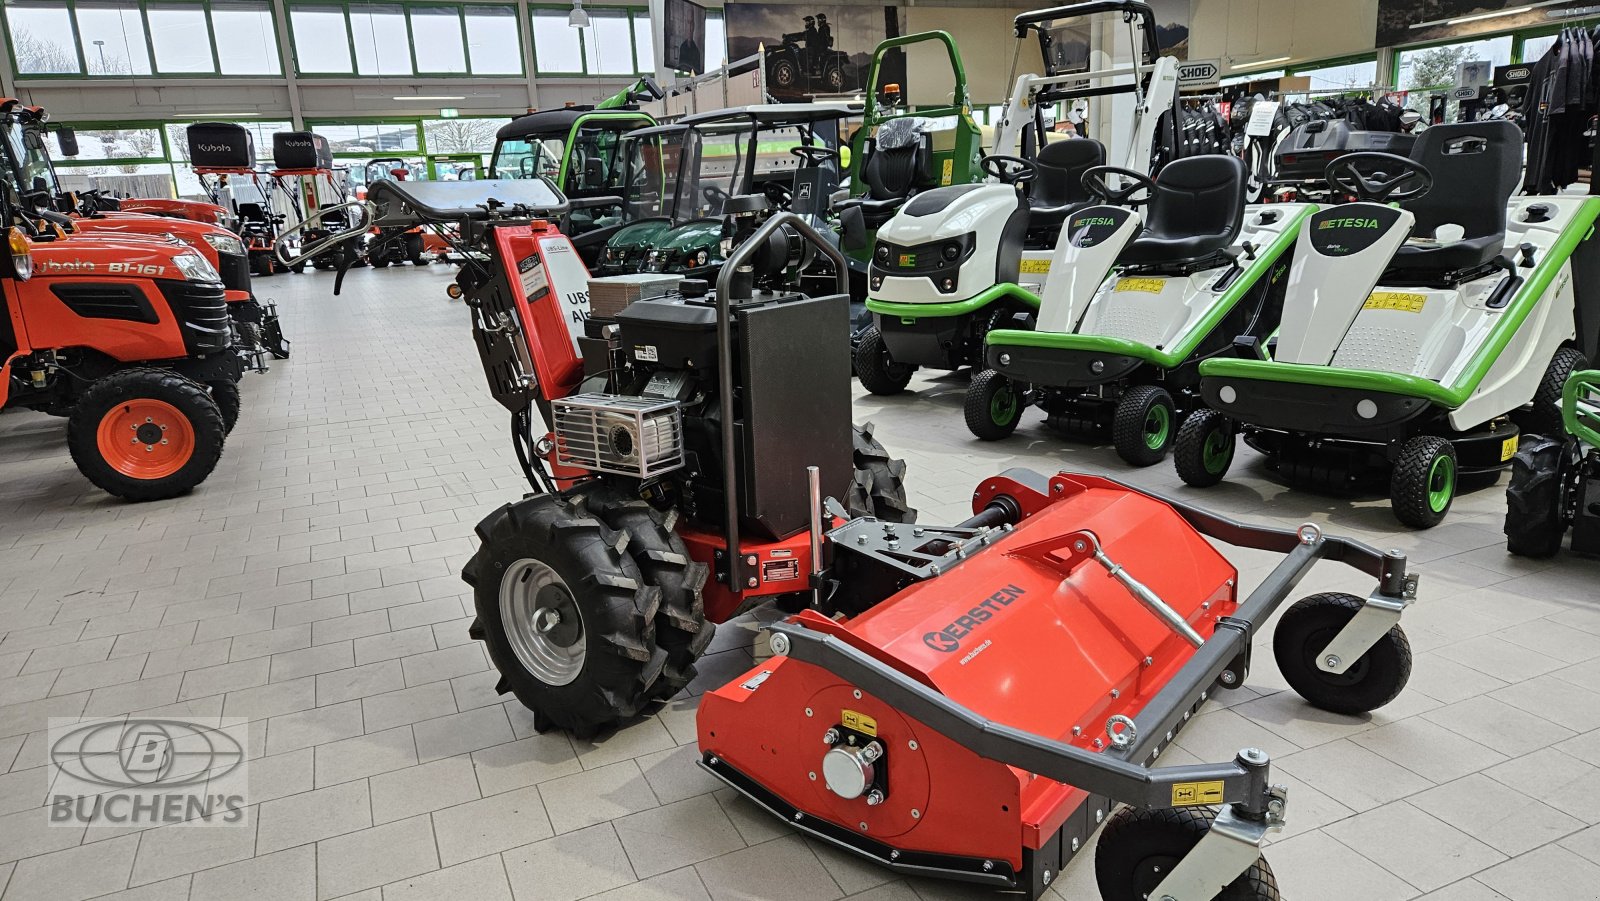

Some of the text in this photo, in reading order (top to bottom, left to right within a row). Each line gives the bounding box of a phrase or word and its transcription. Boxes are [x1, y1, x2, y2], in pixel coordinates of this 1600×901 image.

[1180, 66, 1211, 79] SHOEI
[1508, 69, 1527, 79] SHOEI
[1457, 89, 1473, 97] SHOEI
[198, 143, 231, 152] Kubota
[1074, 217, 1114, 227] ETESIA
[1318, 218, 1379, 230] ETESIA
[34, 258, 95, 273] ubota
[922, 583, 1027, 653] KERSTEN
